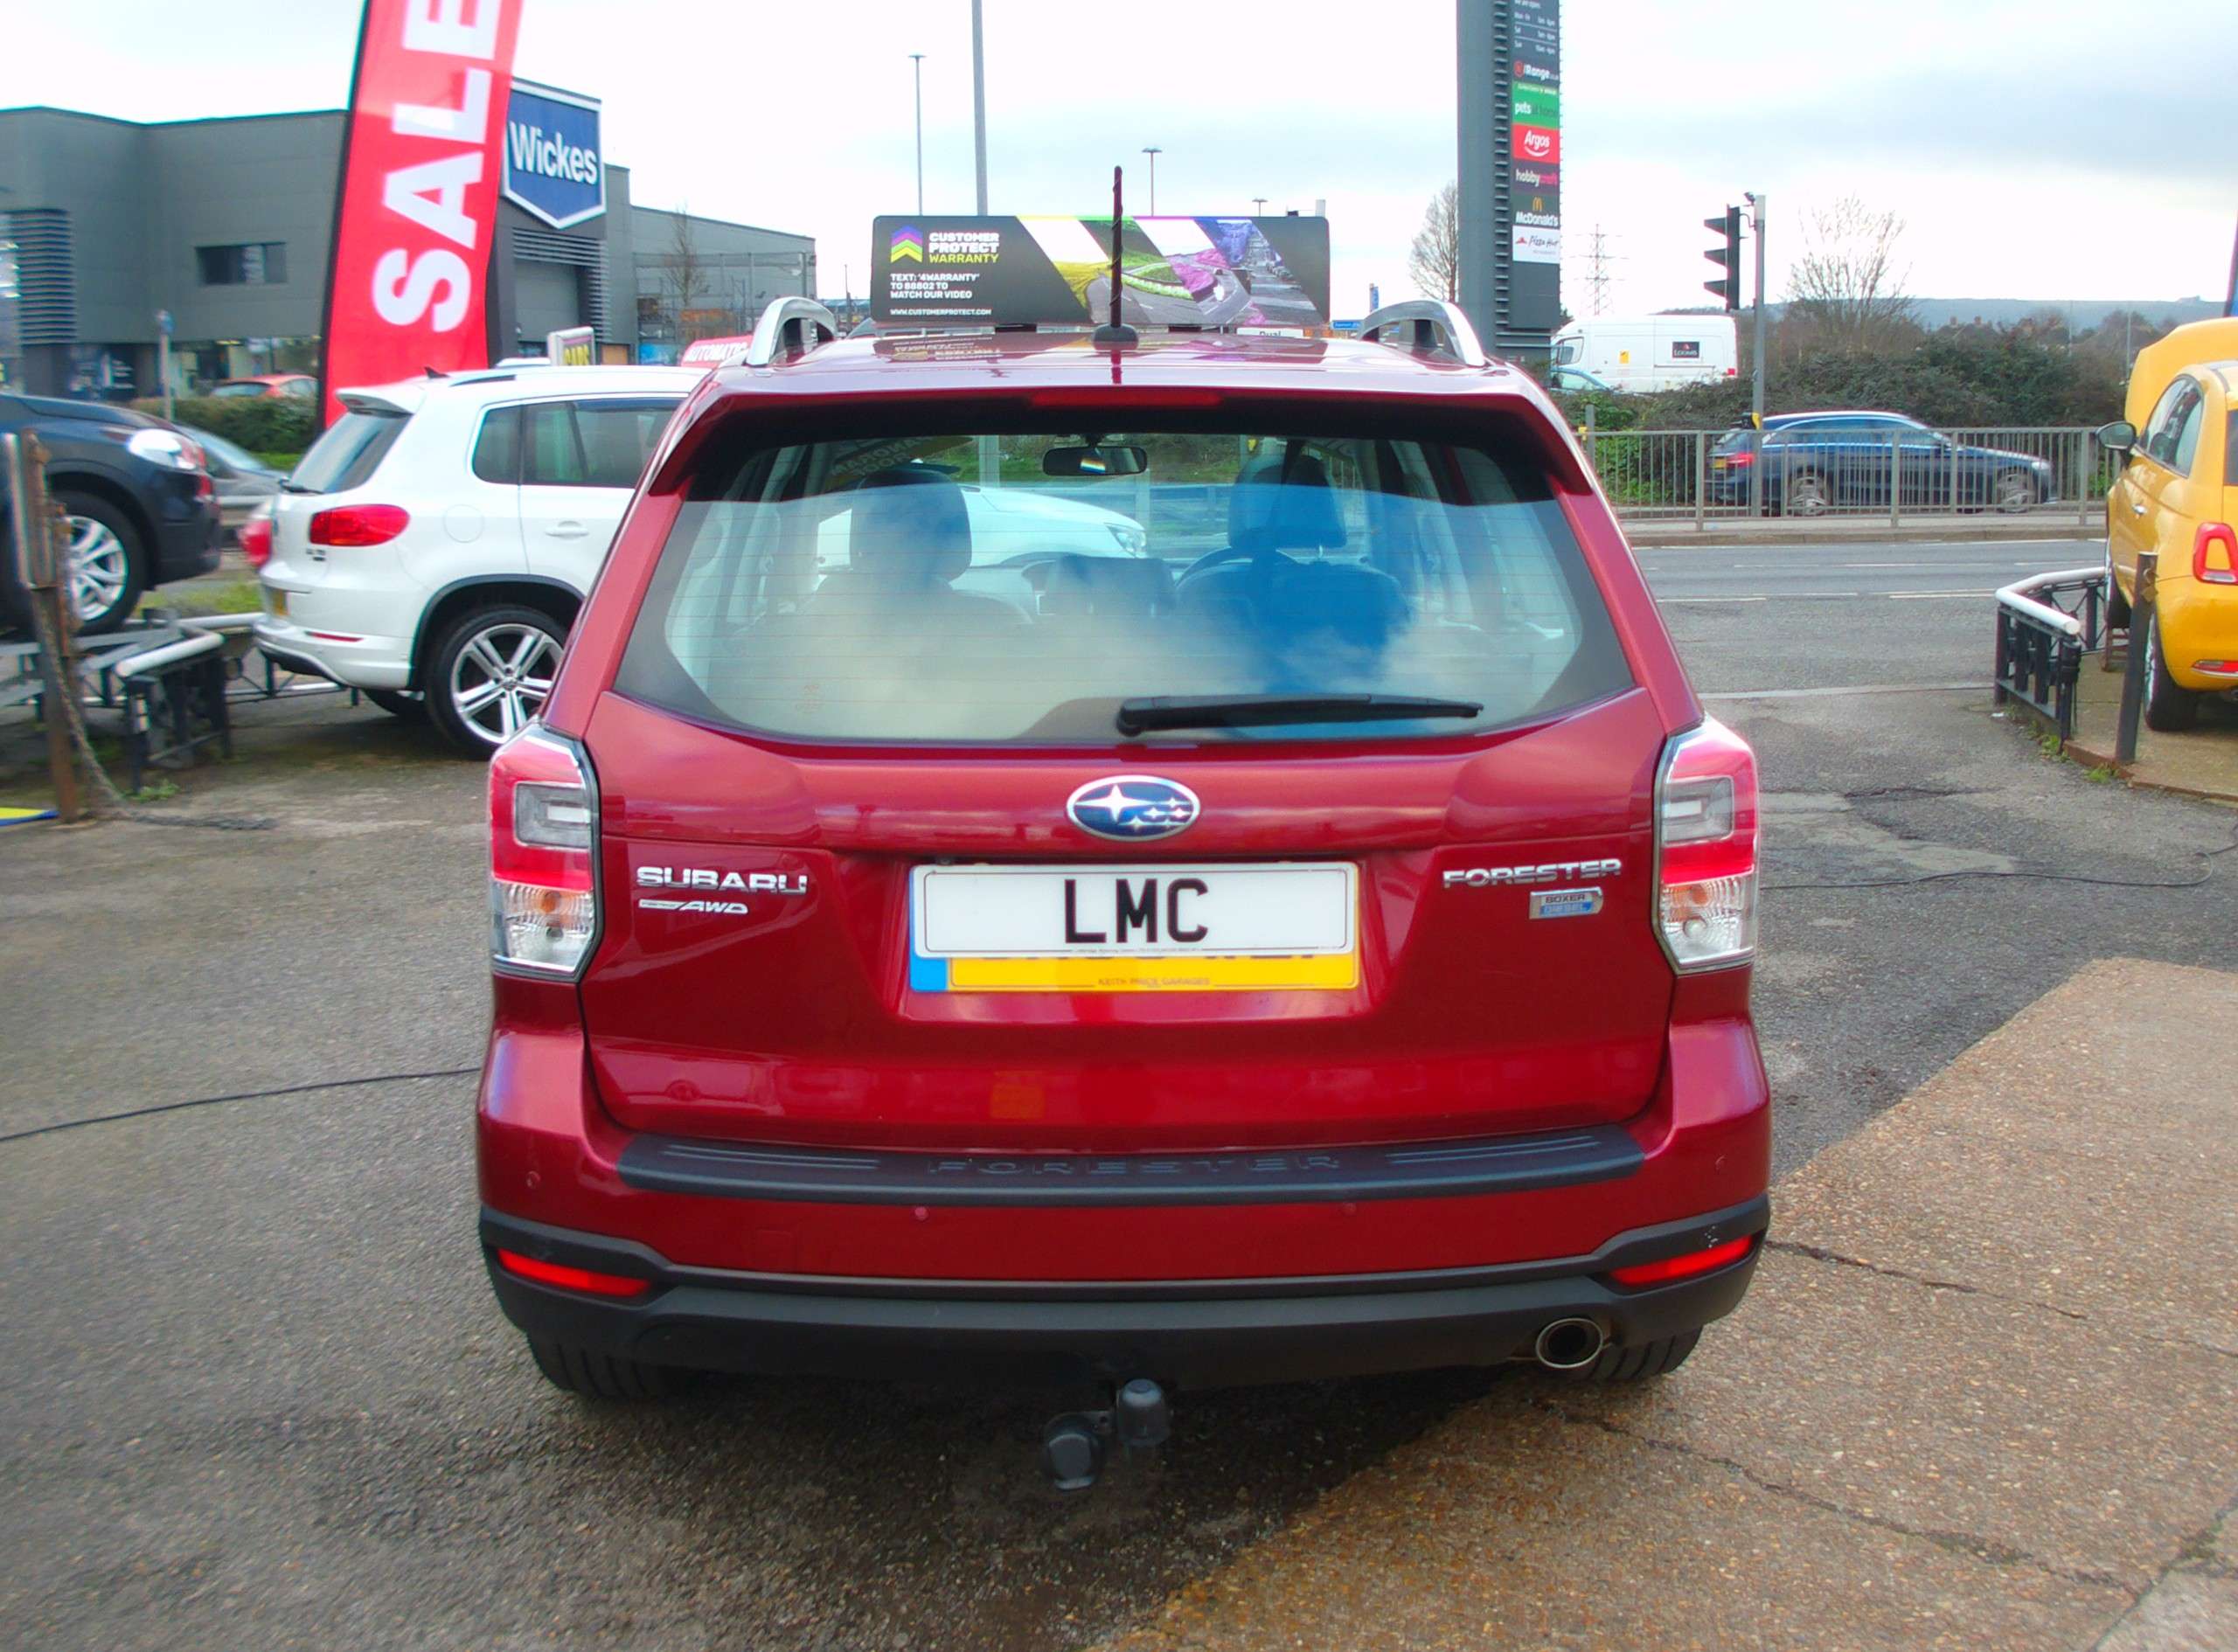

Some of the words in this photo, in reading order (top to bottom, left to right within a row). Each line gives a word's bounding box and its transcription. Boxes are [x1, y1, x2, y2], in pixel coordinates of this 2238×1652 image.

[1524, 130, 1550, 150] Argos
[510, 121, 598, 185] Wickes
[372, 0, 501, 332] SALE
[928, 232, 999, 242] CUSTOMER
[928, 242, 999, 253] PROTECT
[928, 253, 999, 263] WARRANTY
[890, 273, 917, 281] TEXT:
[890, 281, 903, 290] TO
[935, 281, 949, 290] TO
[890, 290, 922, 299] WATCH
[923, 290, 943, 299] OUR
[944, 290, 972, 299] VIDEO
[636, 866, 809, 894] SUBARU
[1442, 858, 1622, 889] FORESTER
[1545, 893, 1586, 904] BOXER
[679, 899, 749, 915] AWD
[1064, 878, 1209, 944] LMC
[928, 1156, 1340, 1175] FORESTER
